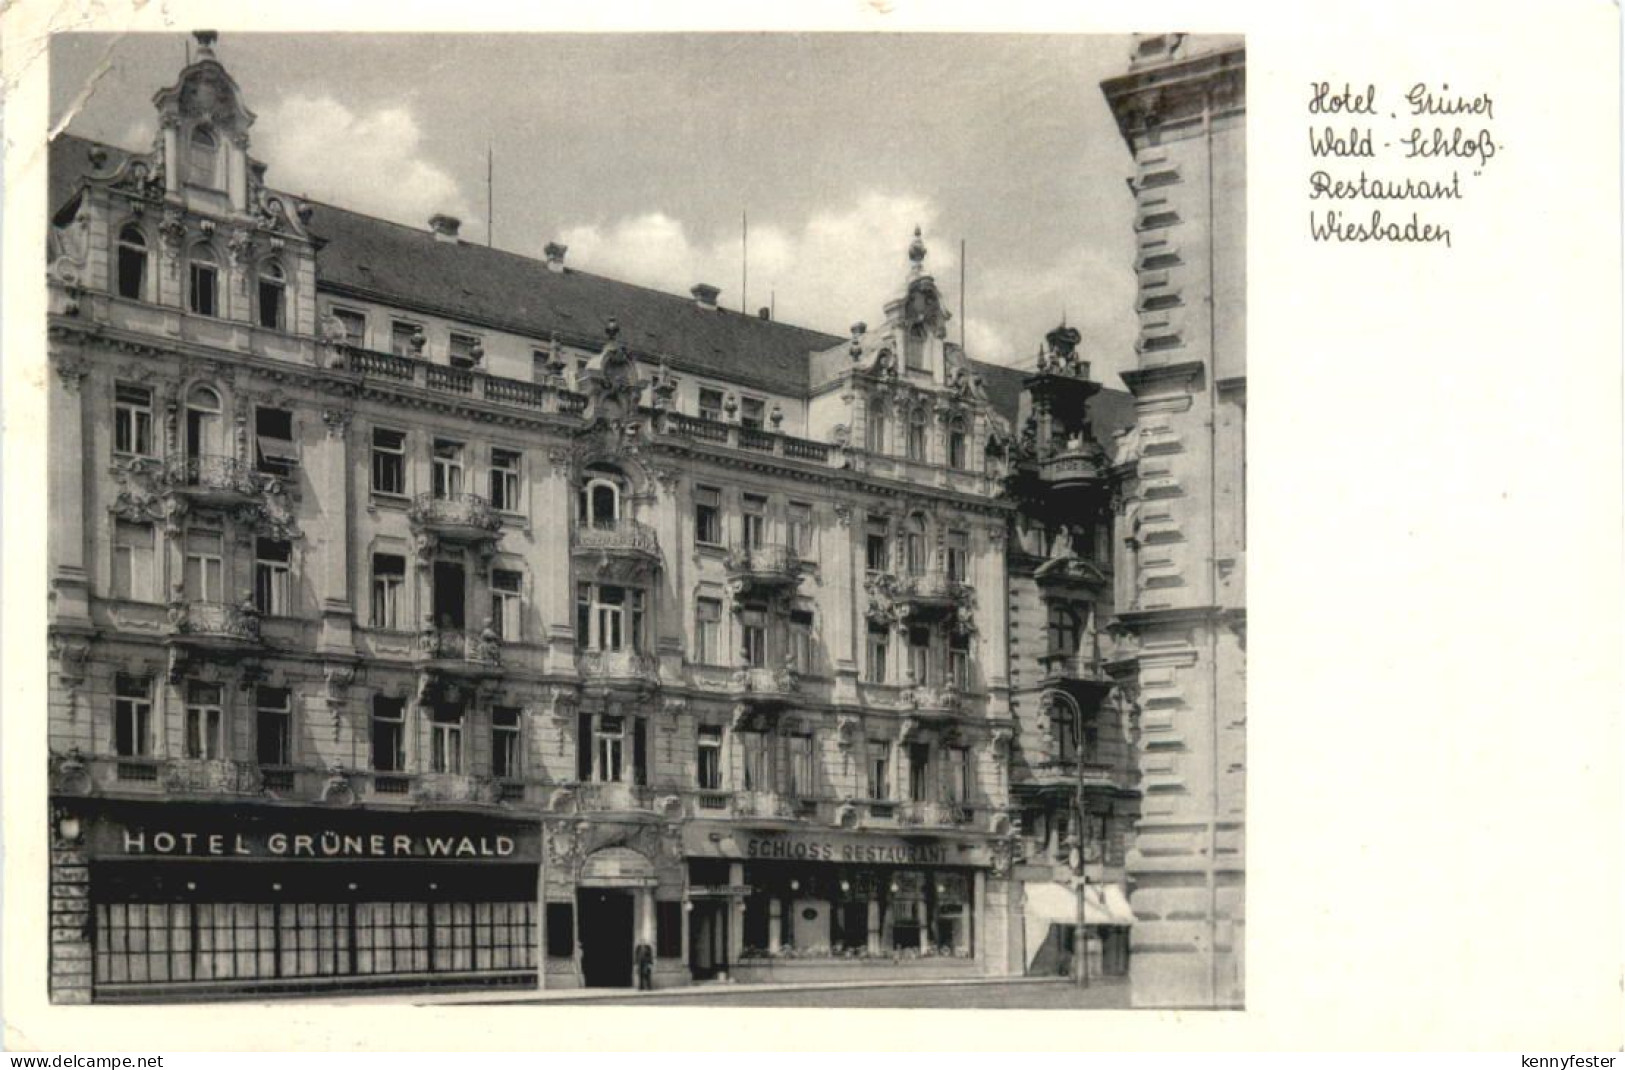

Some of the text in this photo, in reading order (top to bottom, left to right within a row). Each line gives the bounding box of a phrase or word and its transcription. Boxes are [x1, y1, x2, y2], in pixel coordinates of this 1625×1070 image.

[1308, 82, 1378, 114] Hotel
[1309, 126, 1375, 158] Wald
[1310, 209, 1451, 248] Wiesbaden
[124, 830, 515, 856] HOTEL GRÜNER WALD
[748, 840, 948, 863] SCHLOSS RESTAURANT
